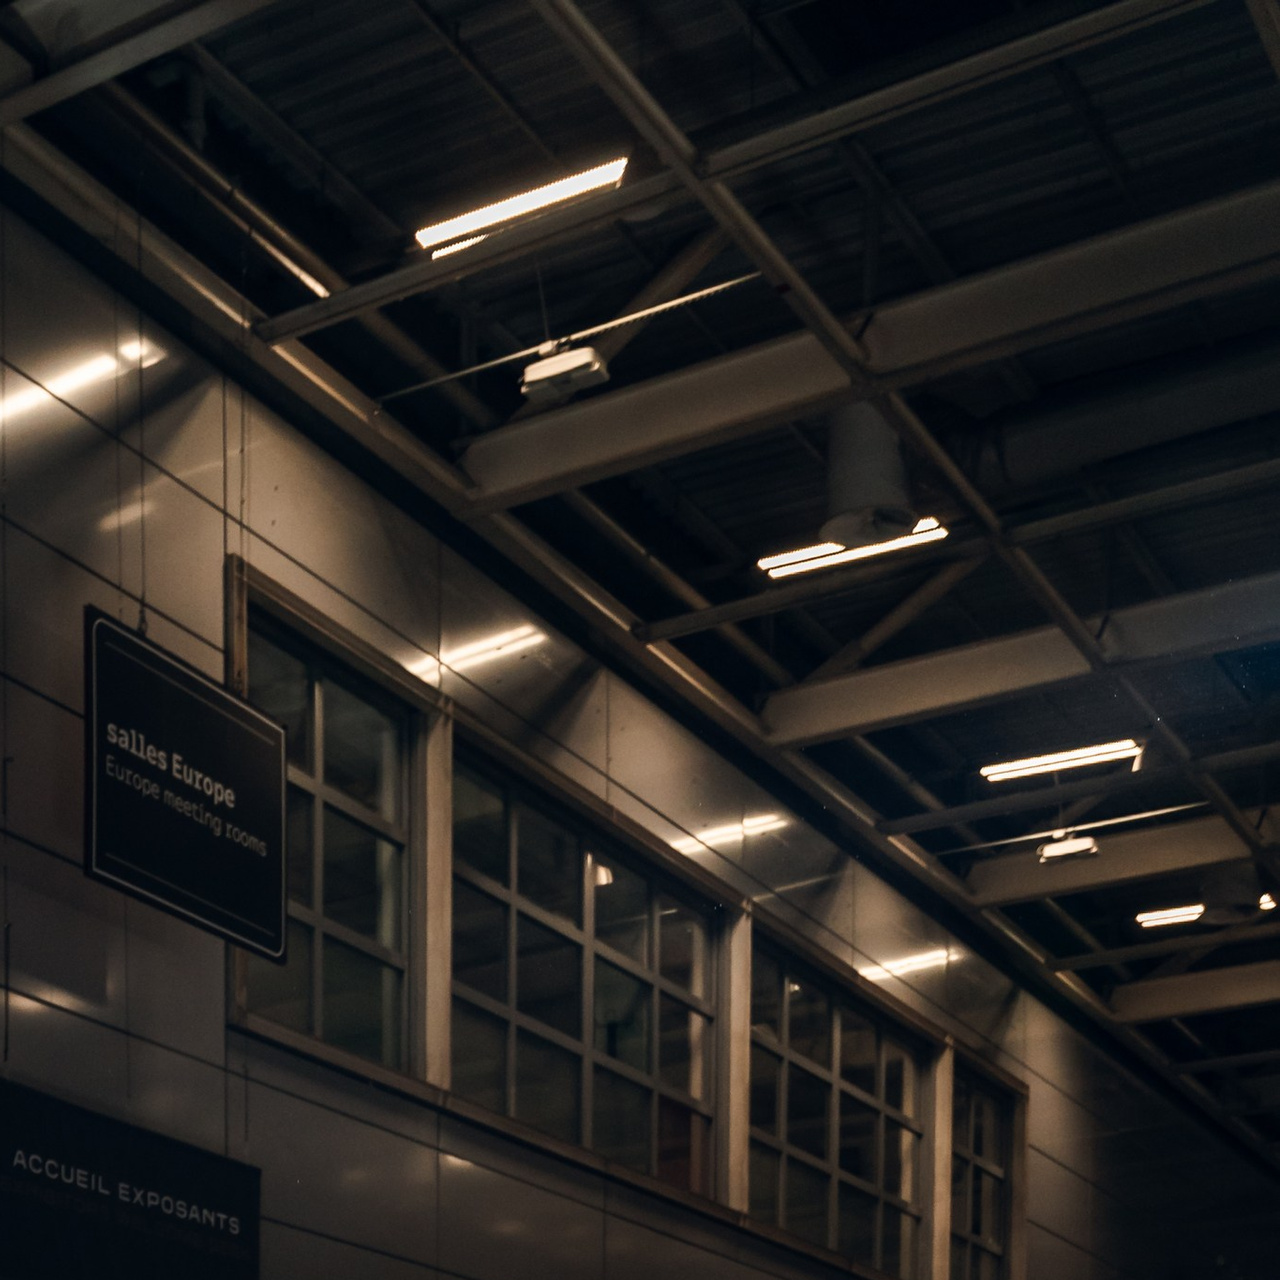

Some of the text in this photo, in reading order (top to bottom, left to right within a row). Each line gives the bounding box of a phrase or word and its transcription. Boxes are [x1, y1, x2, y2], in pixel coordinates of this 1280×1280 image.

[106, 722, 236, 808] salles Europe
[106, 755, 267, 858] Europe meeting rooms
[13, 1149, 111, 1195] ACCUEIL
[119, 1182, 240, 1235] EXPOSANTS
